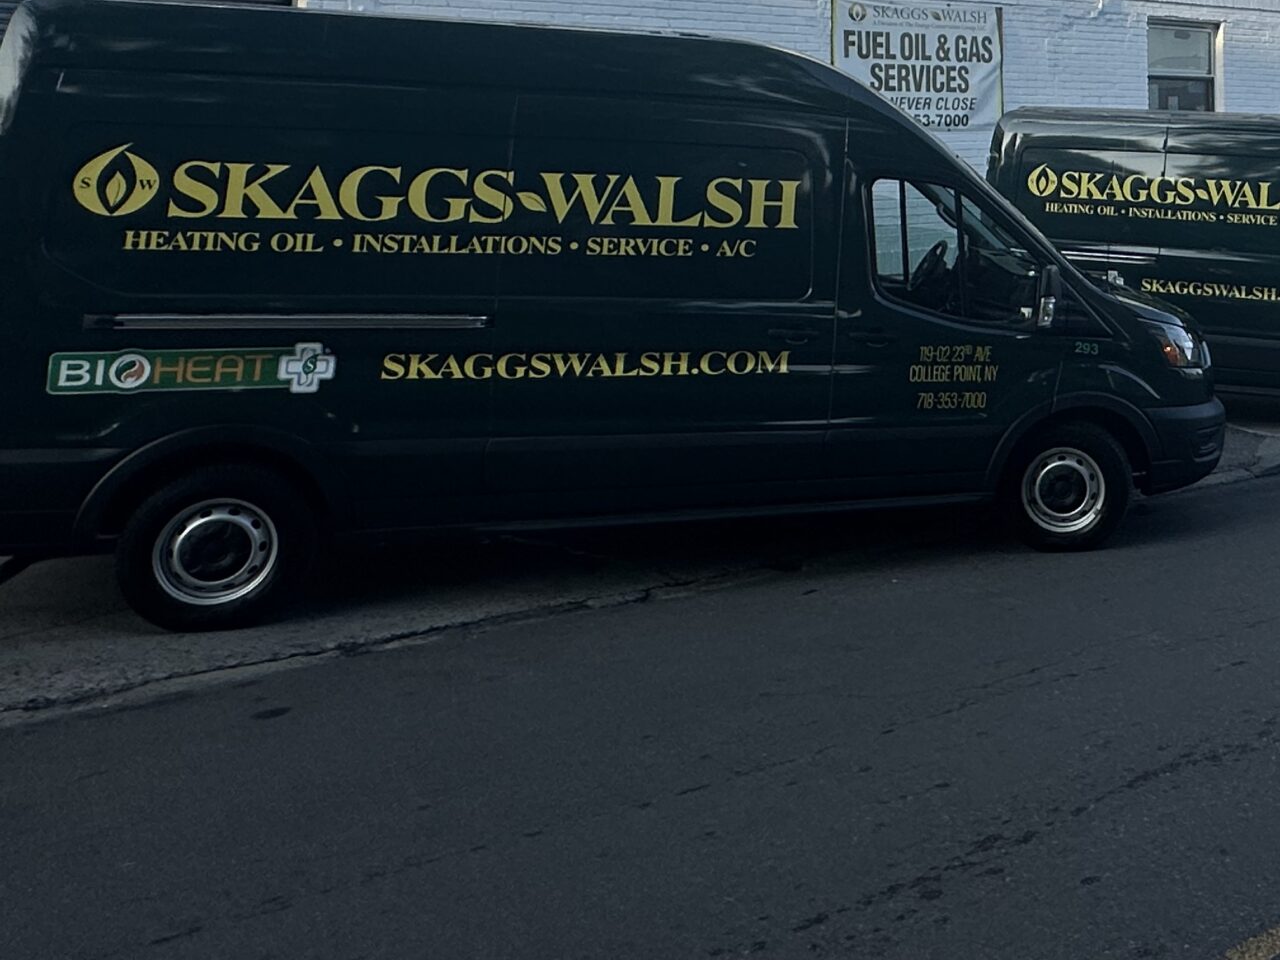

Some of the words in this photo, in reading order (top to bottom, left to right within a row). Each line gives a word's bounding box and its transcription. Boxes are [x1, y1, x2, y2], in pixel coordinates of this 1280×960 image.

[873, 5, 929, 20] SKAGGS
[941, 9, 987, 24] WALSH
[843, 29, 896, 60] FUEL
[900, 32, 931, 61] OIL
[935, 34, 952, 62] &
[955, 35, 993, 63] GAS
[870, 63, 969, 93] SERVICES
[935, 97, 977, 111] CLOSE
[79, 177, 91, 189] S
[139, 179, 157, 191] W
[1045, 202, 1094, 214] HEATING
[1097, 205, 1118, 216] OIL
[1128, 207, 1217, 222] INSTALLATIONS
[1226, 212, 1278, 226] SERVICE
[123, 230, 261, 252] HEATING
[270, 232, 324, 253] OIL
[352, 233, 562, 255] INSTALLATIONS
[586, 237, 693, 257] SERVICE
[716, 239, 757, 258] A/C
[974, 346, 993, 362] AVE
[1074, 341, 1099, 355] 293
[380, 350, 791, 379] SKAGGSWALSH.COM
[909, 365, 951, 382] COLLEGE
[984, 365, 999, 382] NY
[917, 392, 987, 409] 718-353-7000
